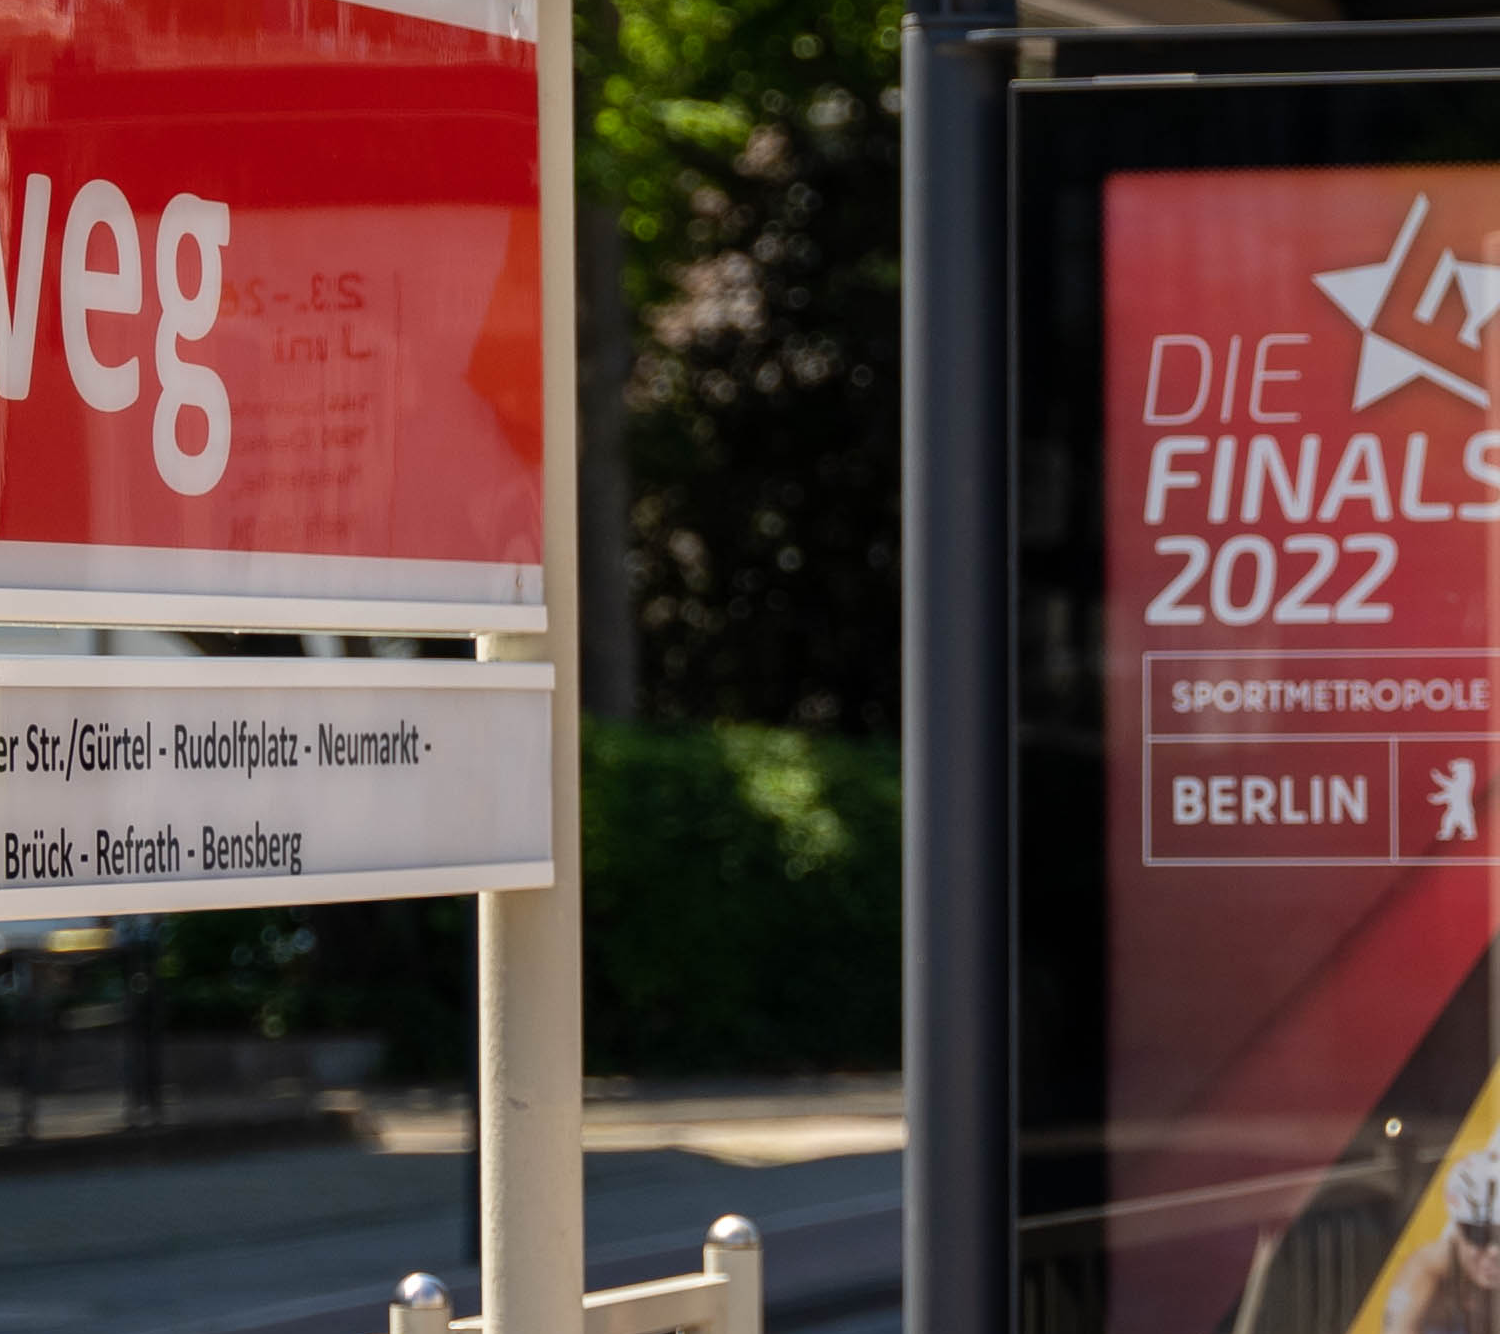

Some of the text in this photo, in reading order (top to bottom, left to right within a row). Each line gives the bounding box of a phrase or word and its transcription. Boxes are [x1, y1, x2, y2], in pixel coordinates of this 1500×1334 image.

[1143, 332, 1311, 426] DIE
[1145, 532, 1399, 627] 2022
[1171, 679, 1490, 713] SPORTMETROPOLE
[25, 717, 151, 783] Str./Gürtel
[174, 720, 298, 780] Rudolfplatz
[318, 719, 419, 766] Neumarkt
[1171, 775, 1369, 826] BERLIN
[4, 827, 74, 880] Brück
[96, 823, 180, 877] Refrath
[202, 821, 303, 877] Bensberg
